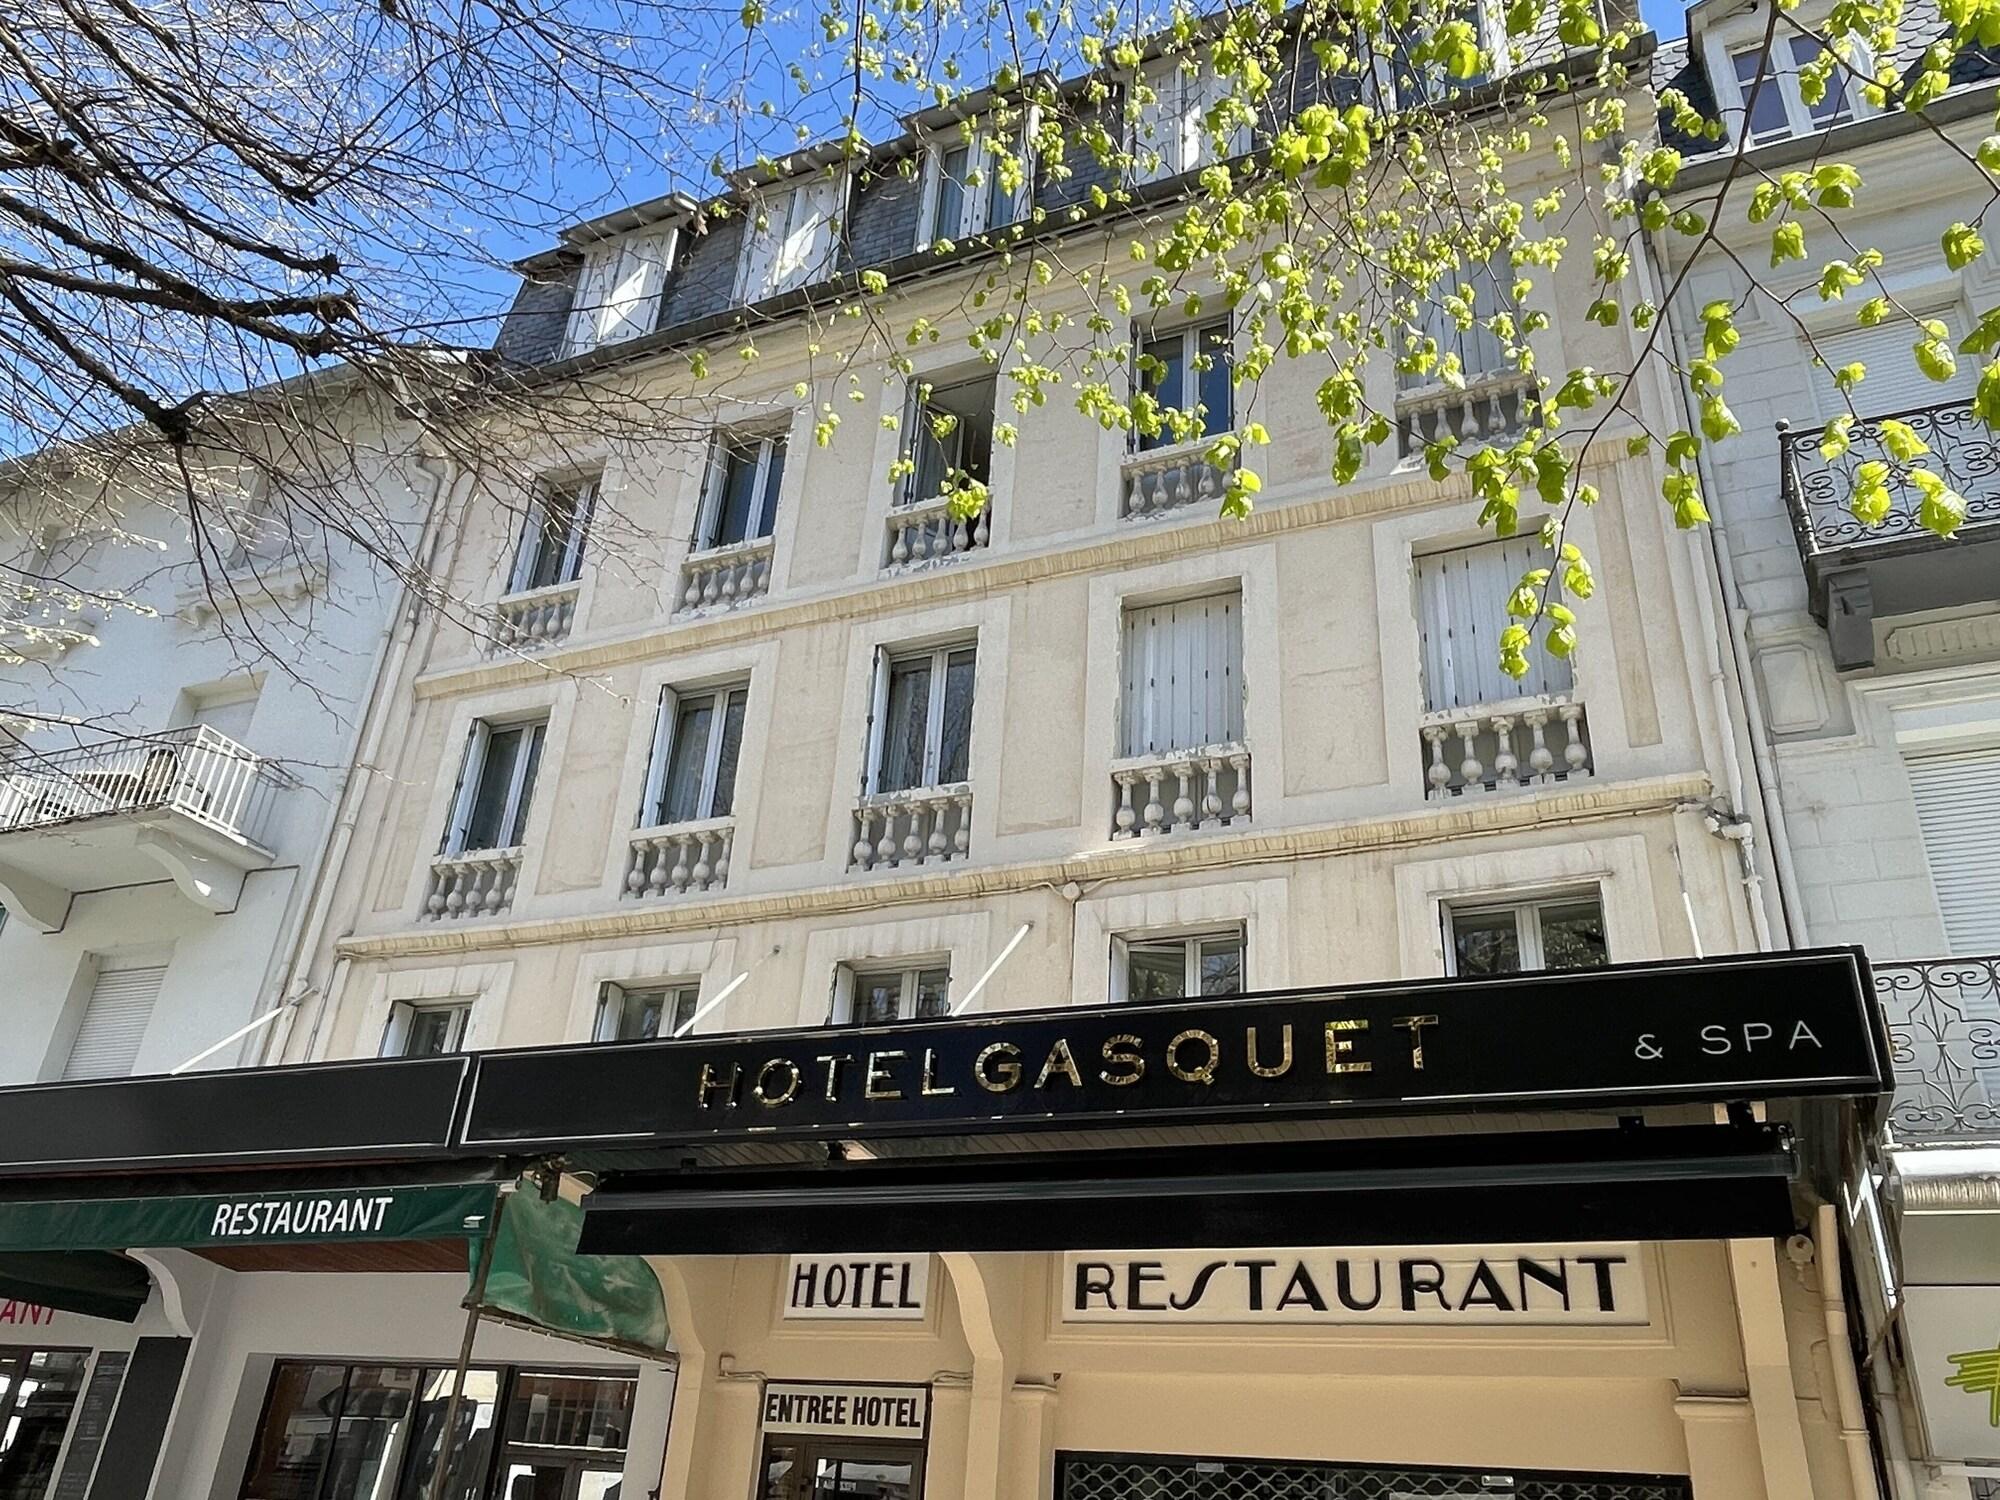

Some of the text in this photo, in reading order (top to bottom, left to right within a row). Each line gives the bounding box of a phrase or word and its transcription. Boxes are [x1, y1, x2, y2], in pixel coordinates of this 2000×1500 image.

[699, 1015, 1823, 1109] HOTEL GASQUET & SPA
[211, 1197, 393, 1236] RESTAURANT
[791, 1262, 921, 1308] HOTEL
[1075, 1257, 1627, 1312] RESTAURANT
[764, 1394, 921, 1428] ENTREE HOTEL
